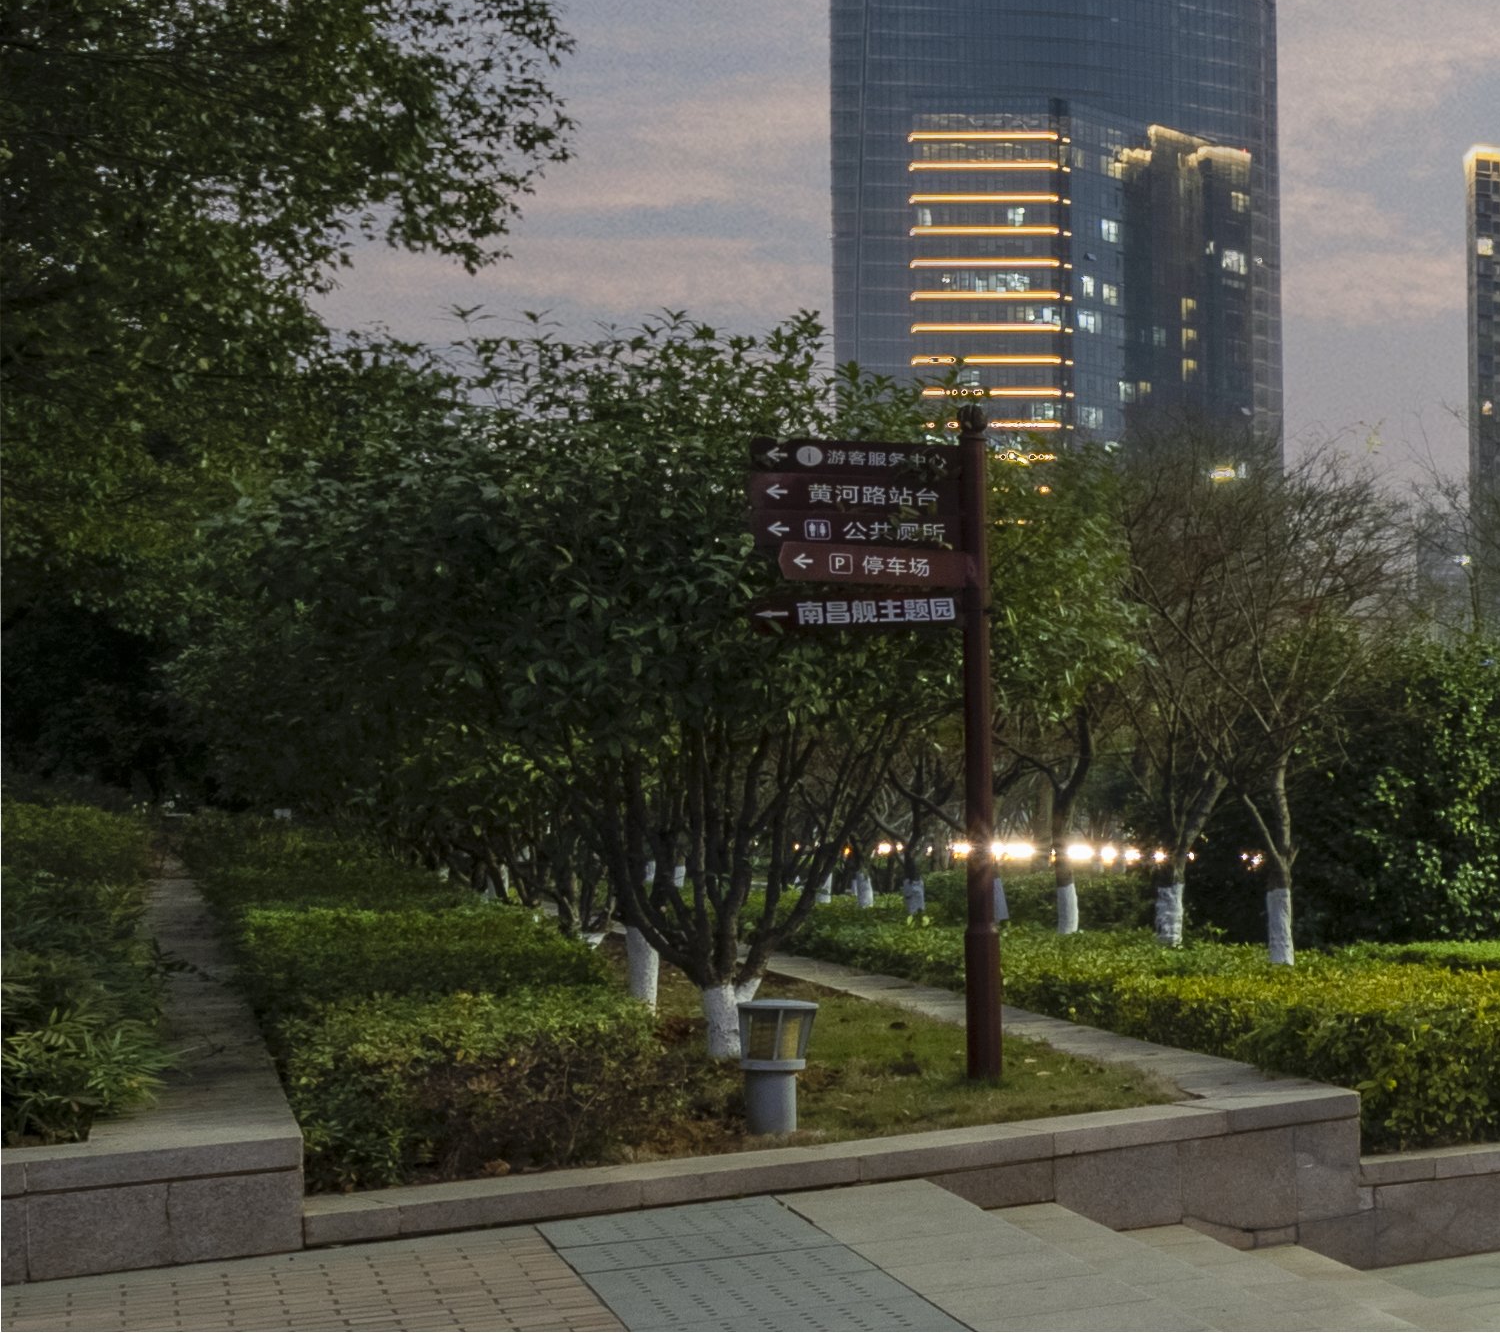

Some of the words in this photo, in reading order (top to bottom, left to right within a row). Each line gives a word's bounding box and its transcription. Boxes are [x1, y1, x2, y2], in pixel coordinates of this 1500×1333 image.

[827, 449, 948, 468] 游客服务中心
[808, 484, 940, 506] 黄河路站台
[843, 521, 946, 542] 公共厕所
[862, 555, 930, 577] 停车场
[797, 597, 956, 625] 南昌舰主题园
